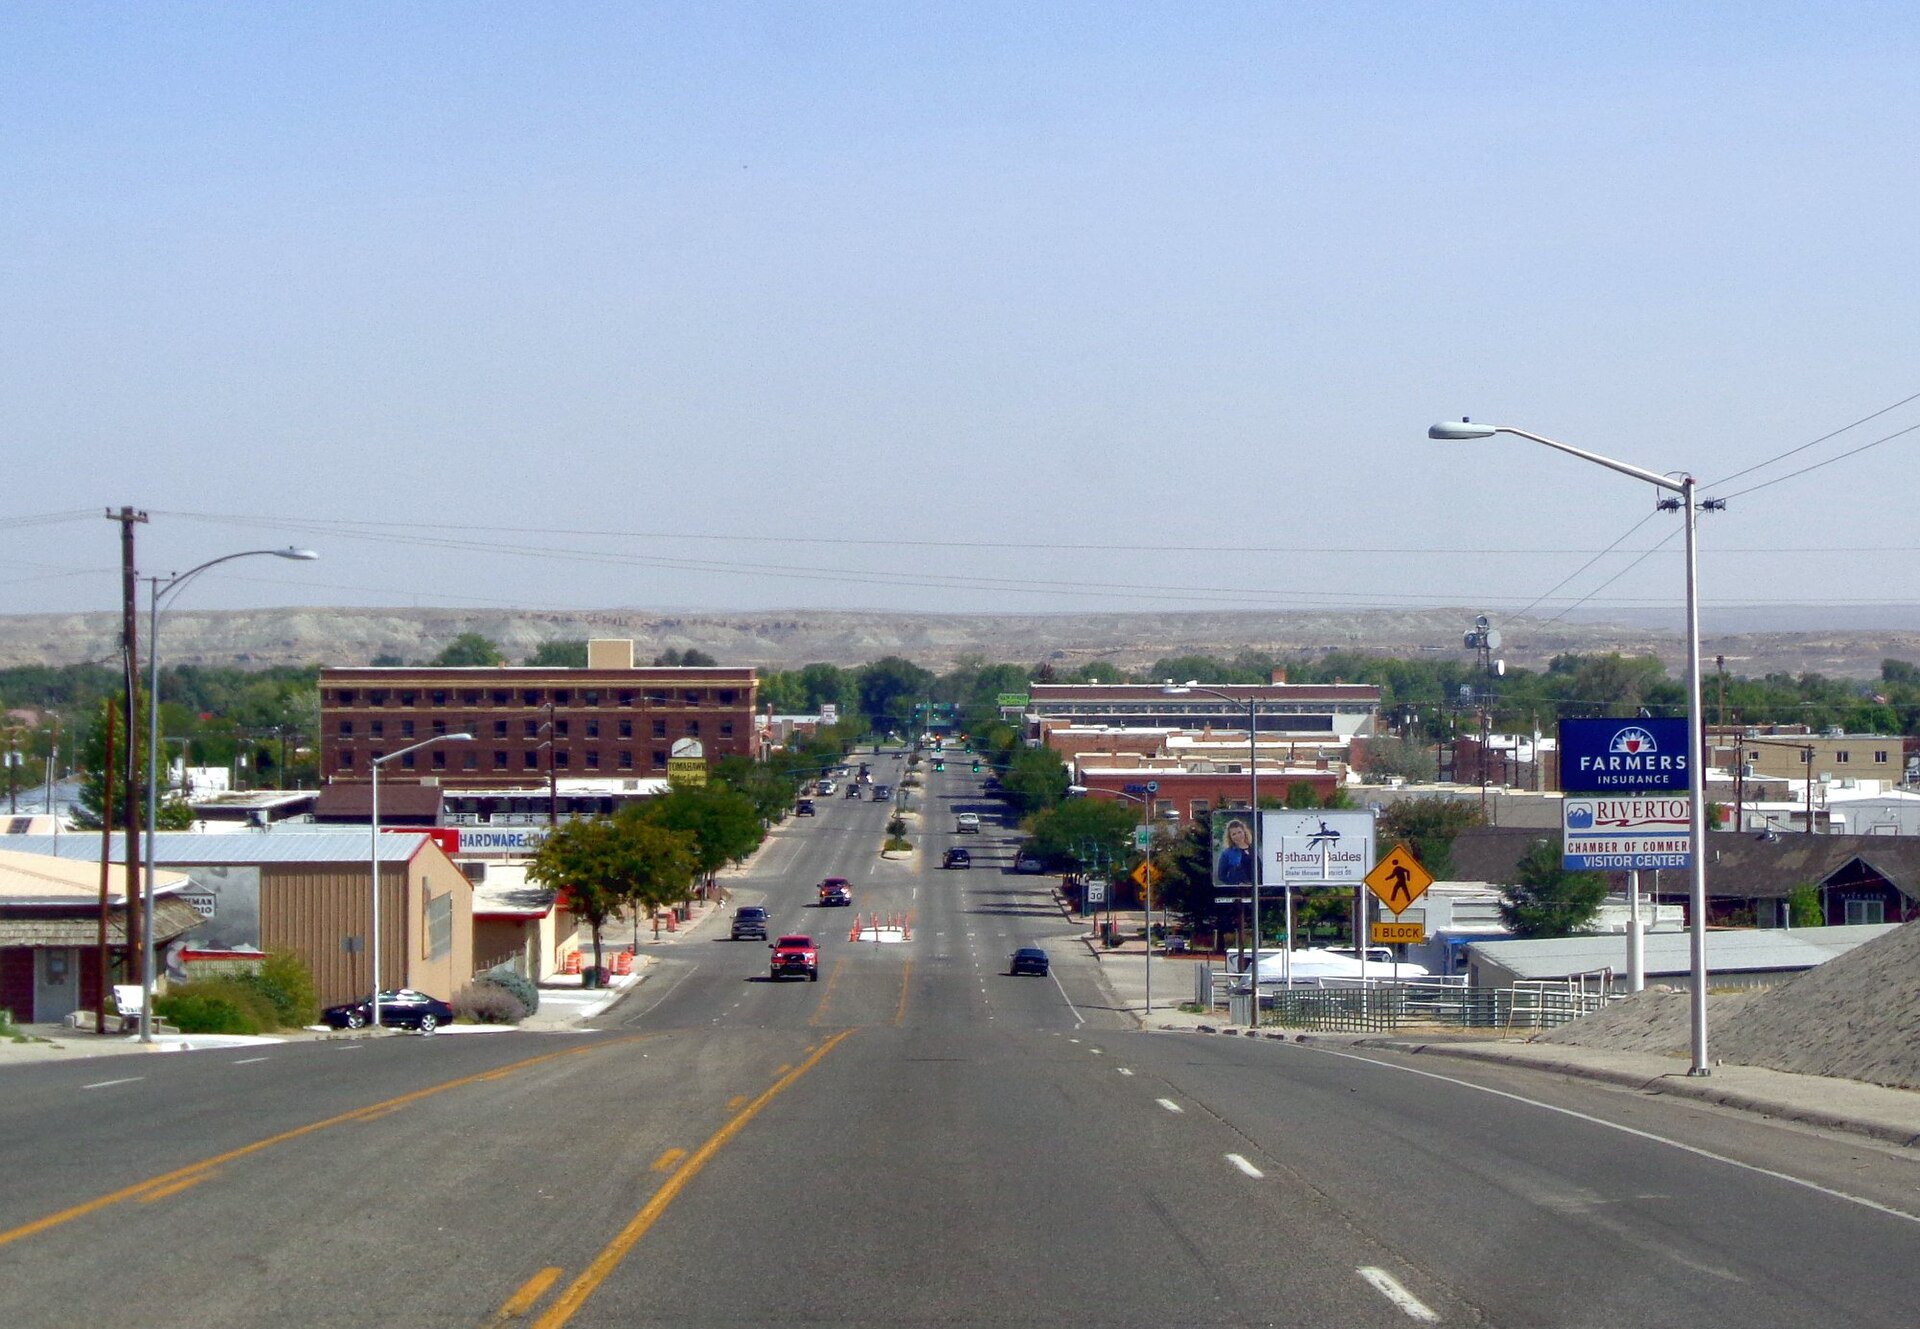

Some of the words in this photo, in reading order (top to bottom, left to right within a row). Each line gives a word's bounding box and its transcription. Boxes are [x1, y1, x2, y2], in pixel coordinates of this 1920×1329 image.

[1580, 755, 1686, 771] FARMERS
[1598, 775, 1669, 784] INSURANCE
[459, 833, 523, 847] HARDWARE
[1568, 842, 1618, 853] CHAMBER
[1624, 841, 1637, 852] OF
[1642, 840, 1690, 852] COMMER
[1276, 851, 1321, 865] Bethany
[1583, 856, 1632, 867] VISITOR
[1636, 855, 1685, 867] CENTER
[1090, 892, 1102, 900] 30
[1373, 927, 1378, 938] 1
[1382, 927, 1420, 938] BLOCK
